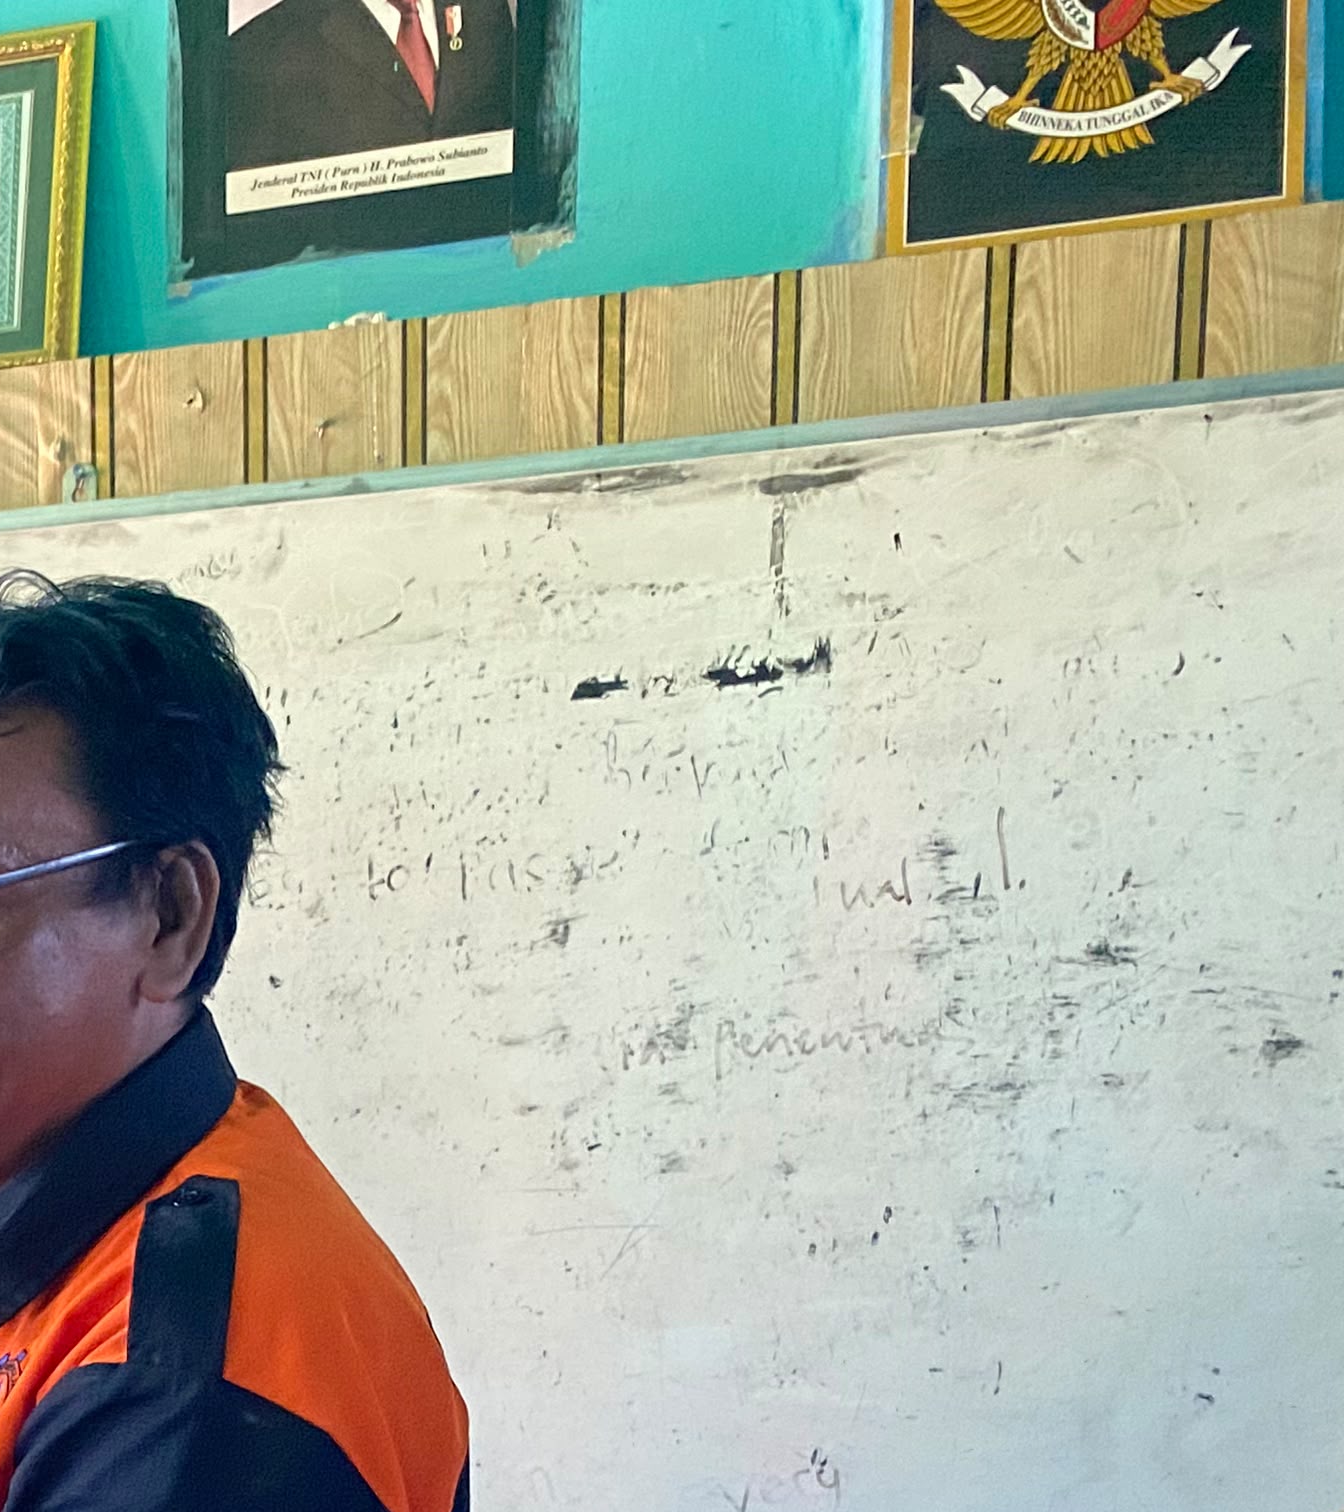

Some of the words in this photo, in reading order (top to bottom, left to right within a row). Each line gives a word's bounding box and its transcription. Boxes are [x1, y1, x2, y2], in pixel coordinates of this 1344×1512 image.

[1017, 109, 1083, 131] BHINNEKA
[1086, 104, 1150, 131] TUNGGAL
[1150, 91, 1174, 111] IKA
[250, 174, 298, 191] Jenderal
[300, 170, 323, 184] TNI
[386, 153, 435, 171] Prabowo
[438, 145, 488, 163] Subianto
[290, 183, 337, 199] Presiden
[340, 175, 388, 192] Republik
[391, 166, 446, 183] Indonesia
